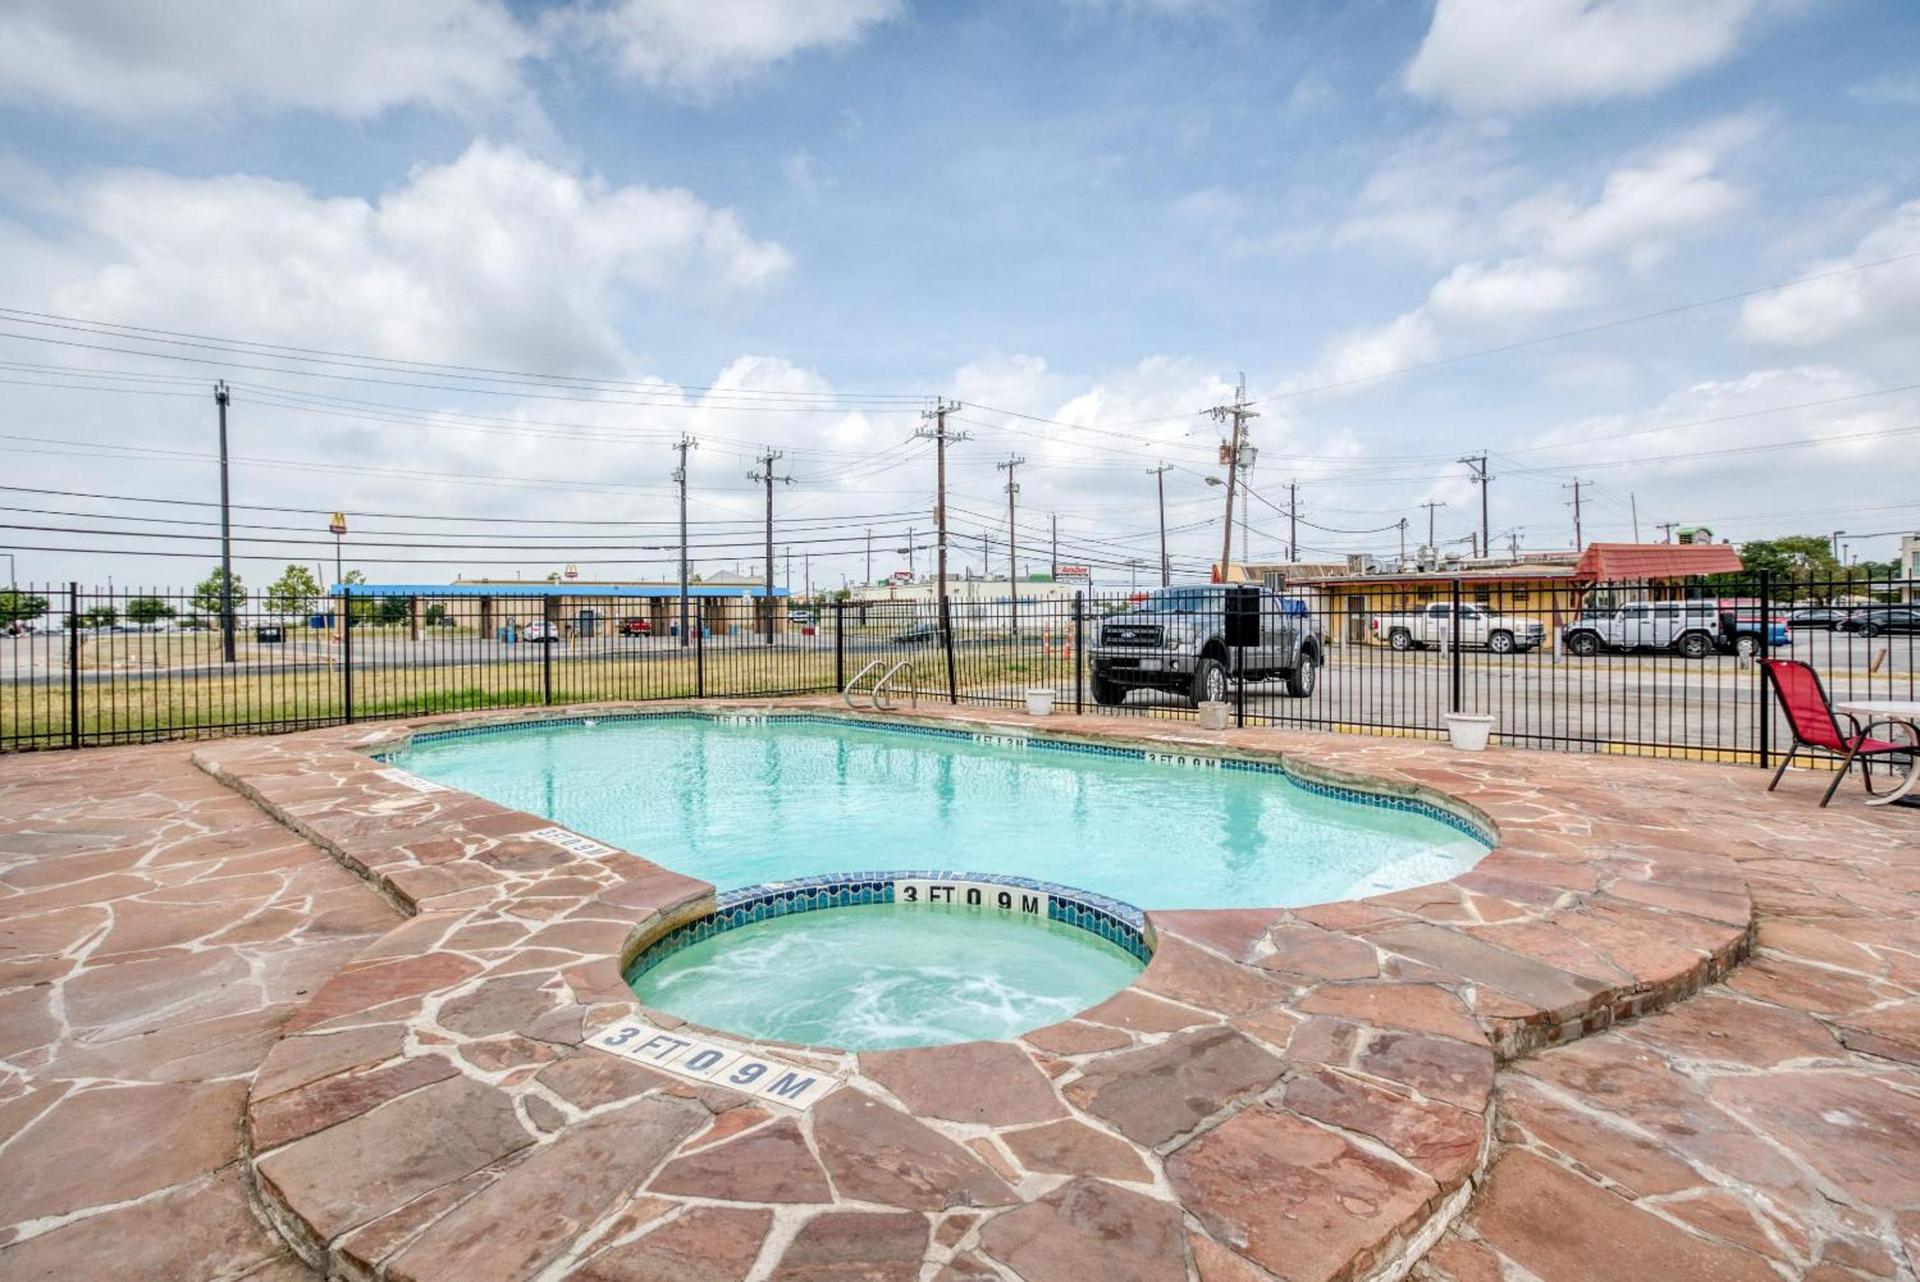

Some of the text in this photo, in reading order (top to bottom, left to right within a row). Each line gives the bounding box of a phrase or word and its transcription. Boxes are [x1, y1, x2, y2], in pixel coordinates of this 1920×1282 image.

[1160, 755, 1172, 765] FT
[903, 886, 918, 903] 3
[930, 886, 955, 904] FT
[1022, 895, 1039, 915] M
[604, 1027, 640, 1046] 3
[632, 1035, 692, 1060] FT
[767, 1072, 817, 1100] M
